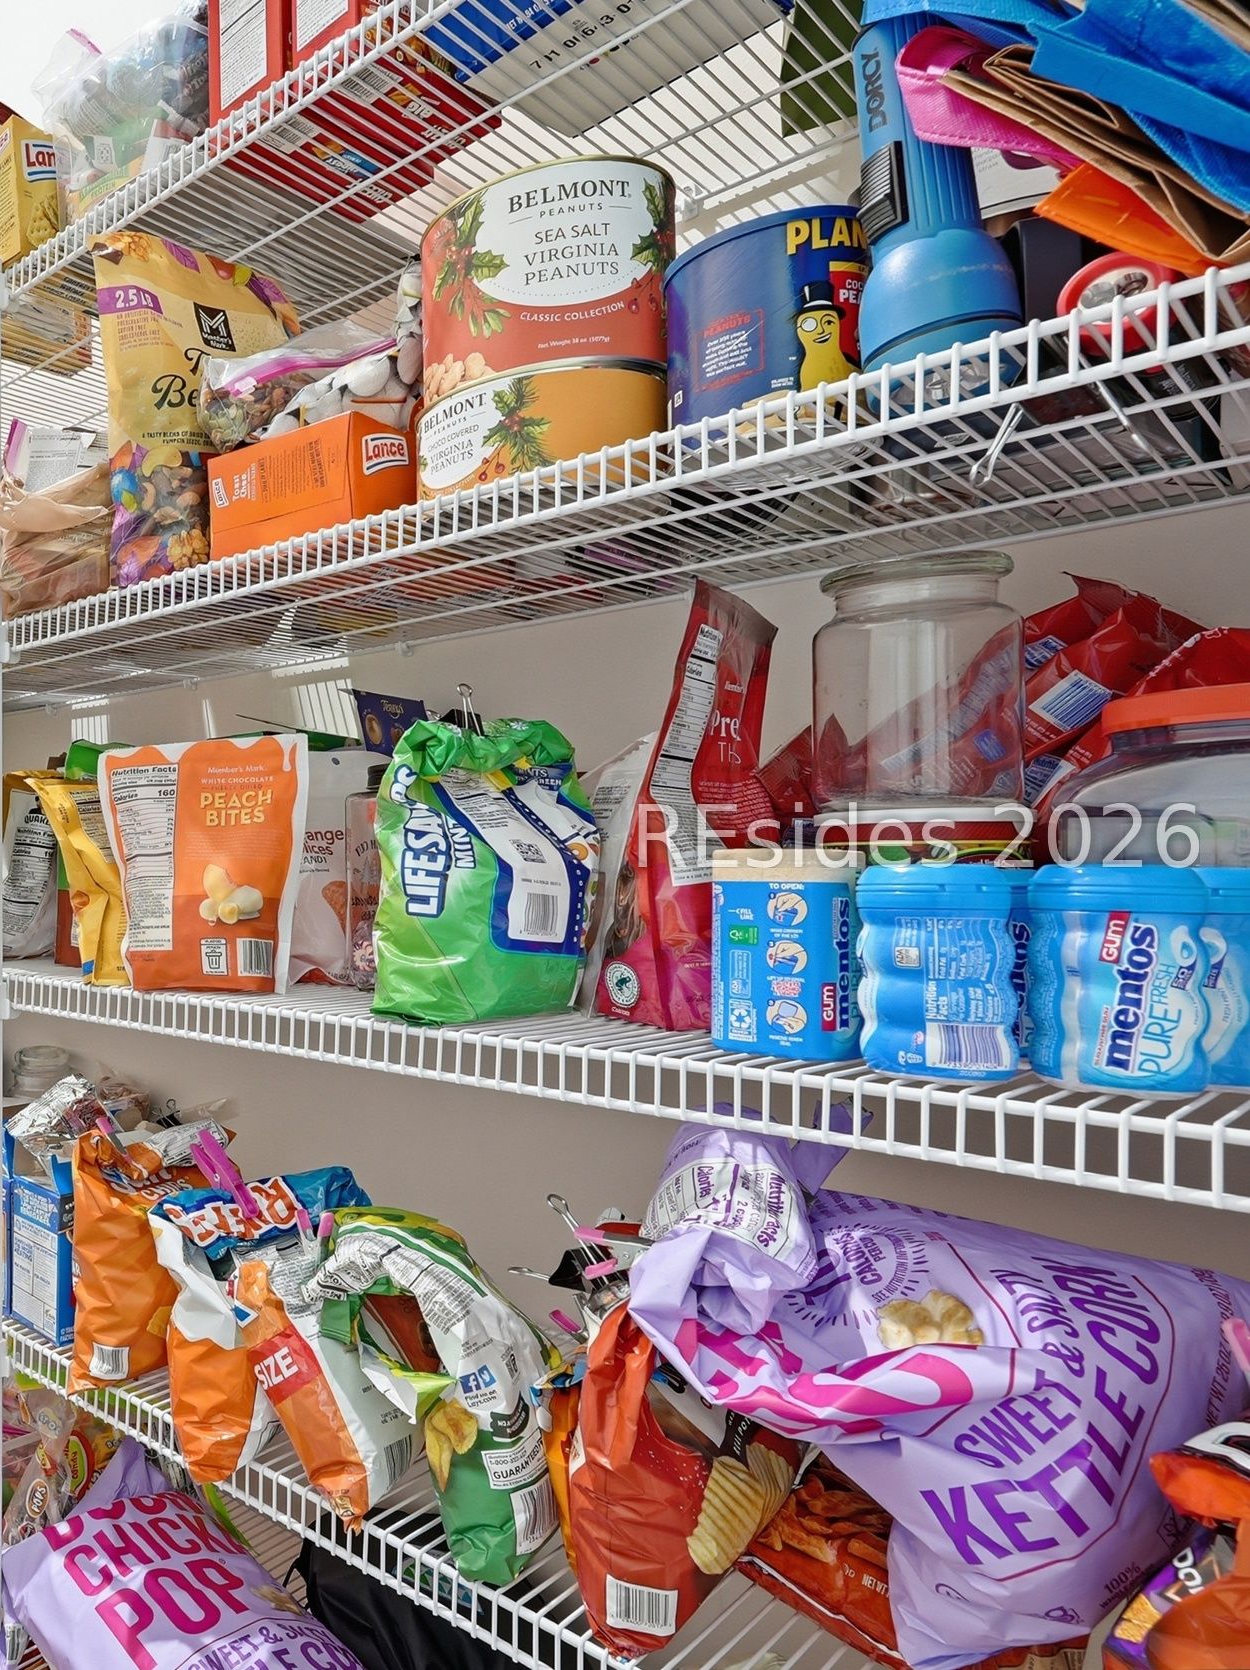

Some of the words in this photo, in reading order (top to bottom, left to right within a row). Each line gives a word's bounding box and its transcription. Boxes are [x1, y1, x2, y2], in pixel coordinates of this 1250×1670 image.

[860, 51, 887, 134] DORCY
[25, 143, 56, 167] Lan
[508, 179, 630, 214] BELMONT
[540, 203, 604, 218] PEANUTS
[534, 227, 569, 245] SEA
[571, 223, 611, 239] SALT
[786, 217, 868, 256] PLAN
[524, 243, 620, 267] VIRGINIA
[524, 261, 620, 286] PEANUTS
[115, 289, 138, 309] 2.5
[139, 289, 154, 308] LB
[520, 311, 561, 322] CLASSIC
[564, 300, 625, 322] COLLECTION
[423, 391, 487, 433] BELMONT
[427, 436, 451, 453] CHOCO
[450, 423, 480, 444] COVERED
[432, 417, 468, 436] PEANUTS
[365, 438, 406, 461] Lance
[429, 438, 475, 465] VIRGINIA
[429, 449, 475, 476] PEANUTS
[111, 769, 150, 778] Nutrition
[152, 765, 178, 775] Facts
[201, 777, 227, 785] WHITE
[228, 775, 275, 784] CHOCOLATE
[208, 764, 244, 774] Member's
[114, 792, 139, 802] Calories
[157, 788, 176, 798] 160
[200, 789, 273, 809] PEACH
[205, 806, 266, 827] BITES
[302, 844, 334, 857] lices
[306, 828, 344, 845] ange
[769, 883, 780, 891] TO
[781, 883, 805, 891] OPEN:
[1102, 918, 1127, 961] GUM
[836, 898, 851, 1031] mentos
[1105, 923, 1159, 1073] mentos
[1153, 964, 1177, 1005] FRESH
[822, 984, 835, 1022] GUM
[1137, 1008, 1182, 1077] PURE
[990, 1269, 1081, 1339] SALTY
[1032, 1255, 1162, 1386] CORN
[256, 1346, 300, 1391] SIZE
[1043, 1342, 1085, 1380] &
[953, 1368, 1085, 1470] SWEET
[493, 1439, 544, 1481] GUARANTEED
[919, 1366, 1147, 1567] KETTLE
[1103, 1562, 1143, 1594] 100%
[94, 1557, 251, 1670] POP
